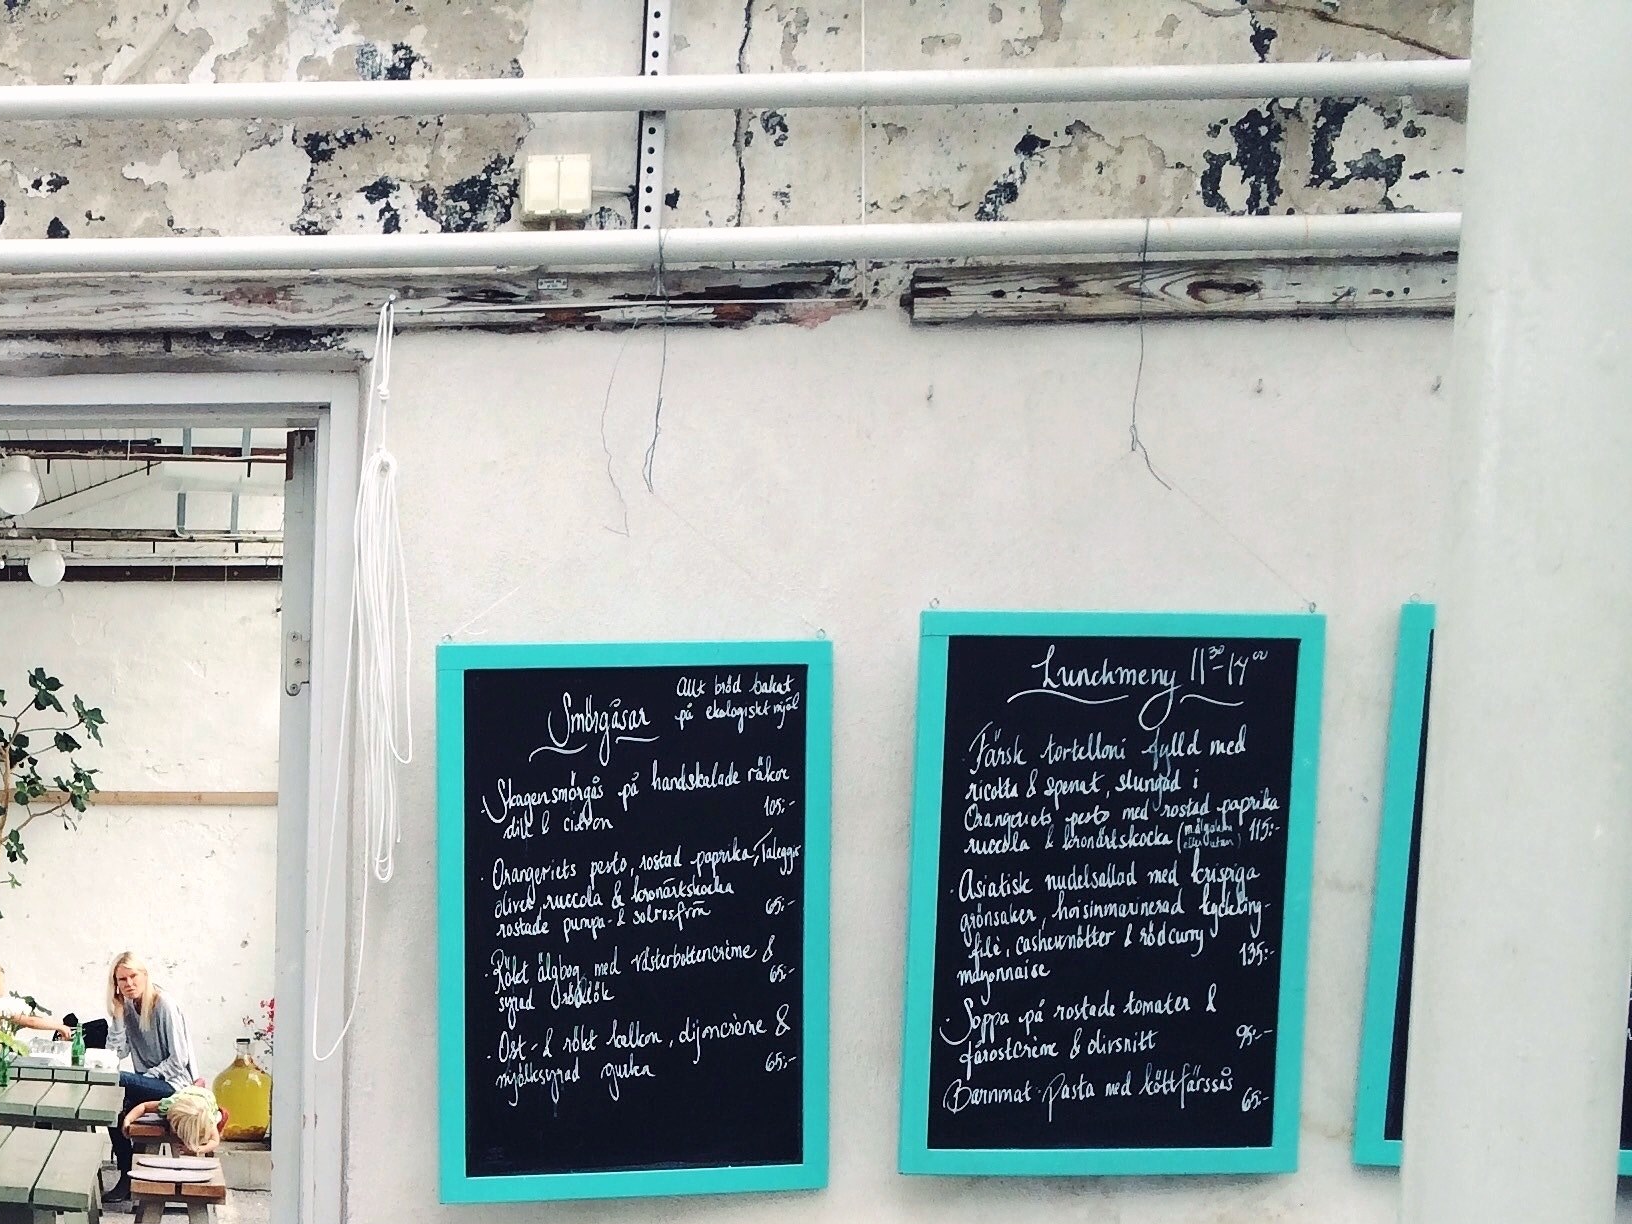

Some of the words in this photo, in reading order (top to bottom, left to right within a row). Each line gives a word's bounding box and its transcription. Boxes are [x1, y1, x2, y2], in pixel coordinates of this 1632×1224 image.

[1031, 644, 1183, 731] Lunchmeny
[547, 691, 651, 767] Smörgåsar
[968, 720, 1028, 775] Färsk
[1039, 731, 1127, 765] tortelloni
[1141, 726, 1203, 777] fylld
[1209, 723, 1247, 757] med
[617, 771, 640, 812] på
[964, 776, 1019, 802] ricotta
[1192, 768, 1200, 790] i
[1122, 797, 1150, 822] med
[1159, 791, 1211, 819] rostad
[1216, 787, 1281, 827] paprika
[1044, 860, 1138, 891] nudelsallad
[1147, 859, 1180, 887] med
[594, 945, 622, 977] med
[956, 958, 1051, 1006] mayonnaise
[774, 1003, 791, 1037] &
[939, 997, 1010, 1046] Soppa
[1018, 998, 1046, 1036] på
[1053, 989, 1116, 1021] rostade
[1122, 990, 1191, 1016] tomater
[1104, 1070, 1132, 1097] med
[1138, 1062, 1234, 1110] köttfärssås
